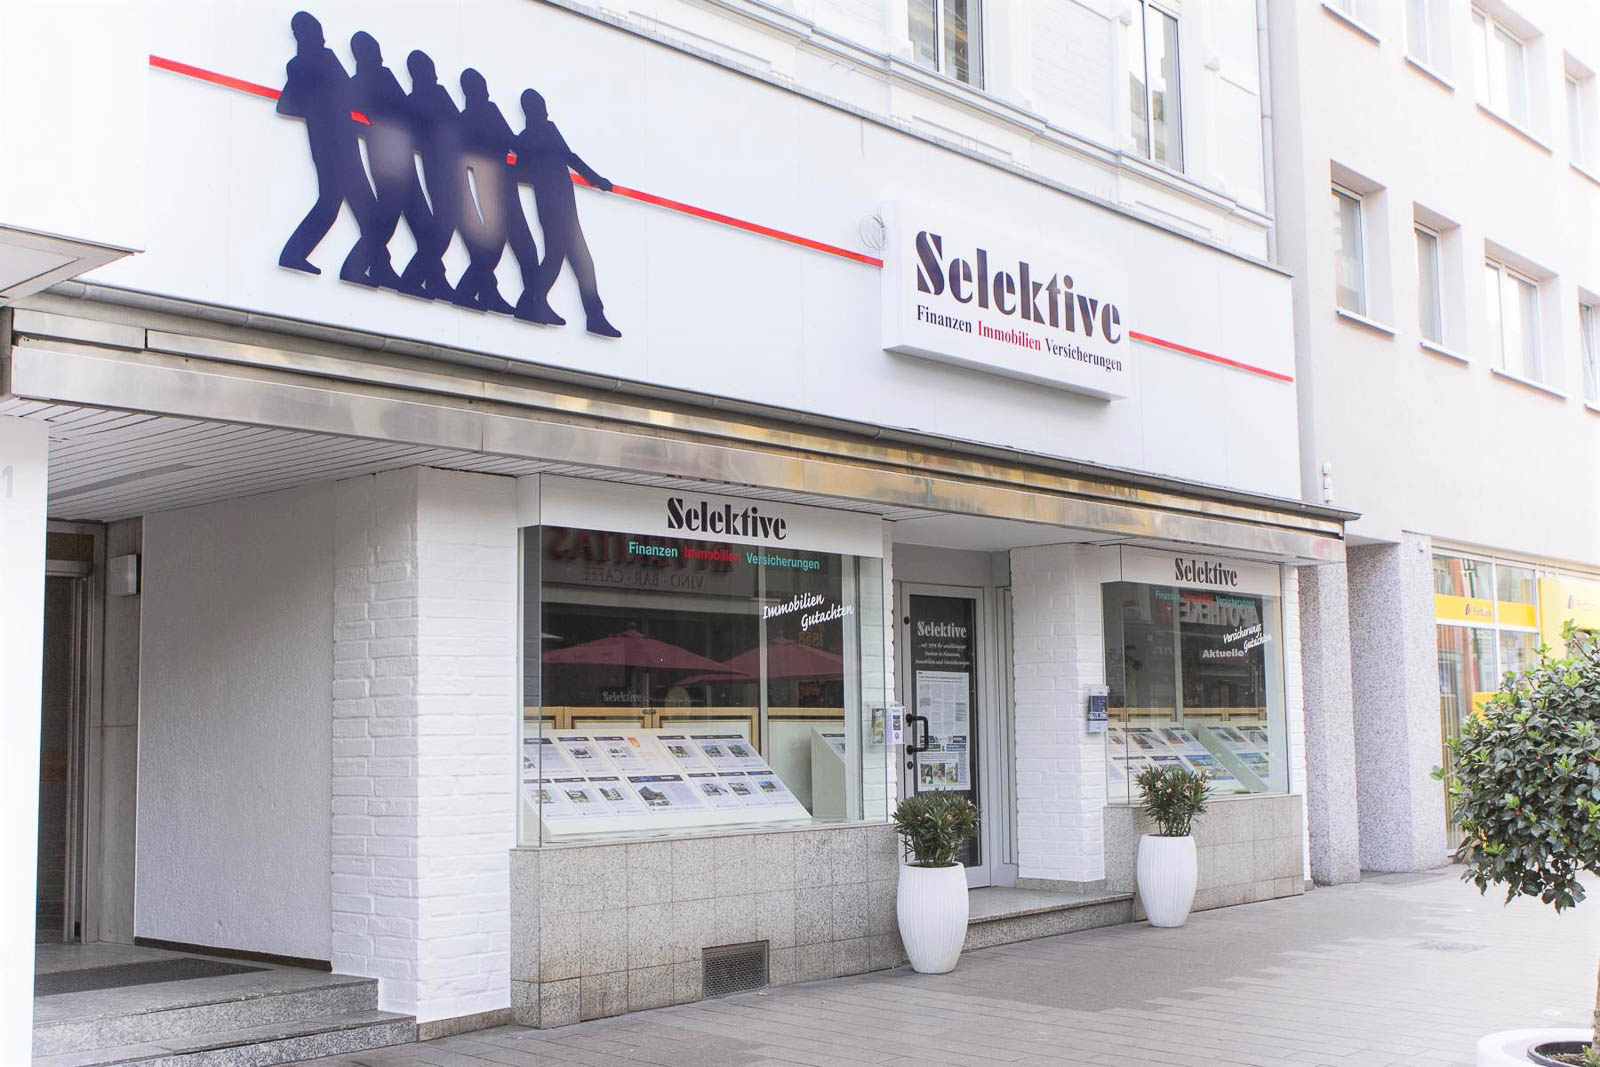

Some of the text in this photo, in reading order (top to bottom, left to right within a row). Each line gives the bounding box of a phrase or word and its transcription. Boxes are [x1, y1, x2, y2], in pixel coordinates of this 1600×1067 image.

[916, 230, 1121, 345] Selektive
[917, 304, 1122, 372] Finanzen Immobilien Versicherungen
[667, 497, 787, 540] Selektive
[628, 541, 678, 558] Finanzen
[684, 546, 741, 563] Immobilien
[746, 551, 820, 570] Versicherungen
[1174, 557, 1238, 587] Selektive
[762, 592, 825, 620] Immobilien
[801, 603, 854, 632] Gutachten
[917, 620, 968, 638] Selektive
[1202, 648, 1245, 659] Aktuelle
[601, 690, 642, 704] Selektive
